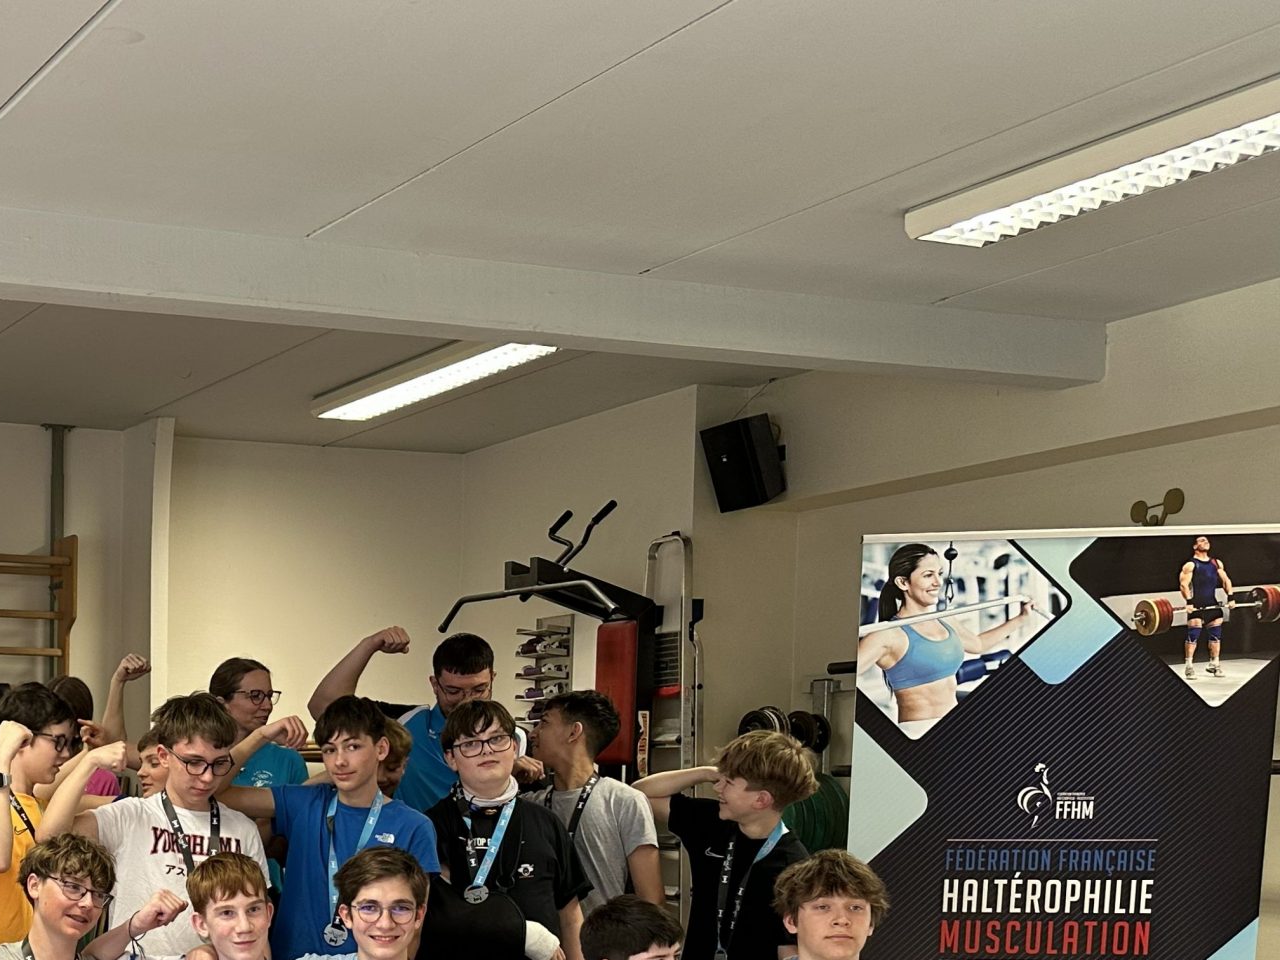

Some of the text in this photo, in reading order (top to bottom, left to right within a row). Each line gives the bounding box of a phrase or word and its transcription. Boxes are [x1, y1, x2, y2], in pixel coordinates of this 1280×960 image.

[1055, 801, 1094, 820] FFHM
[945, 844, 1157, 876] FÉDÉRATION FRANÇAISE
[941, 872, 1154, 914] HALTÉROPHILIE
[938, 919, 1151, 955] MUSCULATION
